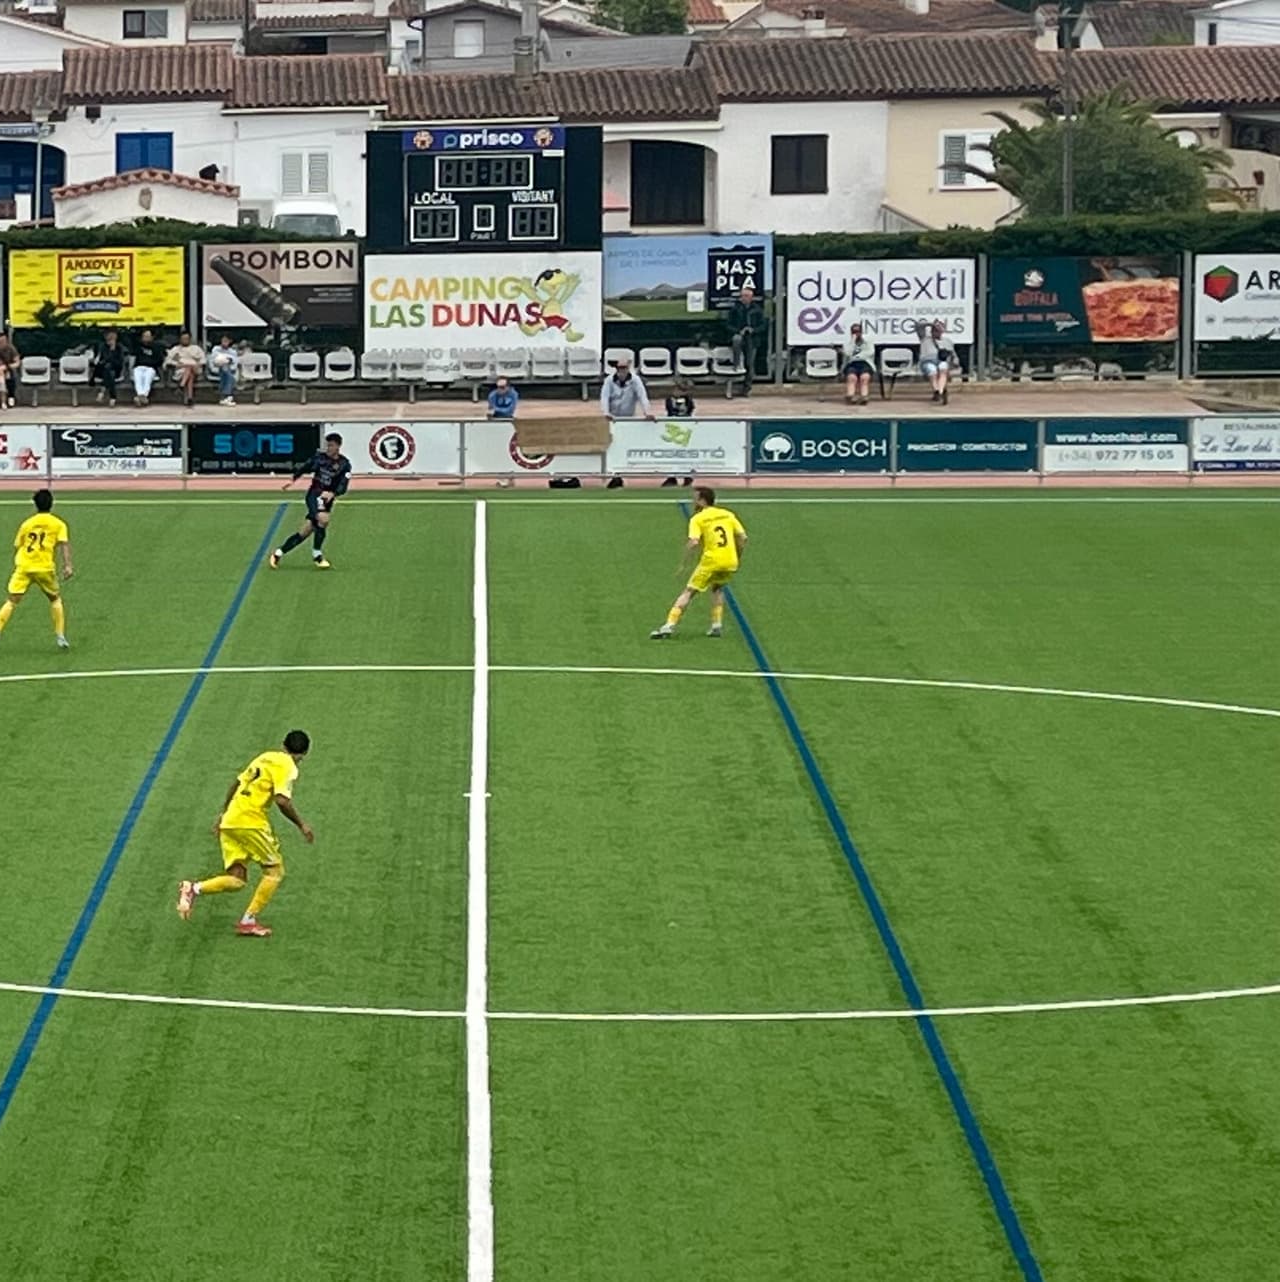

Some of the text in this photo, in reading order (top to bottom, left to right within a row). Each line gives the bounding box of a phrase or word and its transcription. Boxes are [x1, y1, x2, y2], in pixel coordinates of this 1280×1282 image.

[460, 128, 524, 149] prisco
[414, 192, 456, 205] LOCAL
[64, 258, 125, 272] ANXOVES
[228, 250, 354, 270] BOMBON
[716, 258, 757, 274] MAS
[64, 285, 127, 299] L'ESCALA
[369, 276, 523, 301] CAMPING
[716, 275, 757, 291] PLA
[797, 268, 966, 305] duplextil
[369, 302, 543, 329] LAS DUNAS
[798, 306, 846, 335] ex
[860, 317, 965, 334] INTEGLS
[801, 439, 887, 458] BOSCH
[1095, 450, 1119, 461] 972
[1122, 450, 1137, 461] 77
[1140, 450, 1155, 461] 15
[1157, 450, 1174, 461] 05
[26, 532, 46, 553] 21
[714, 525, 729, 547] 3
